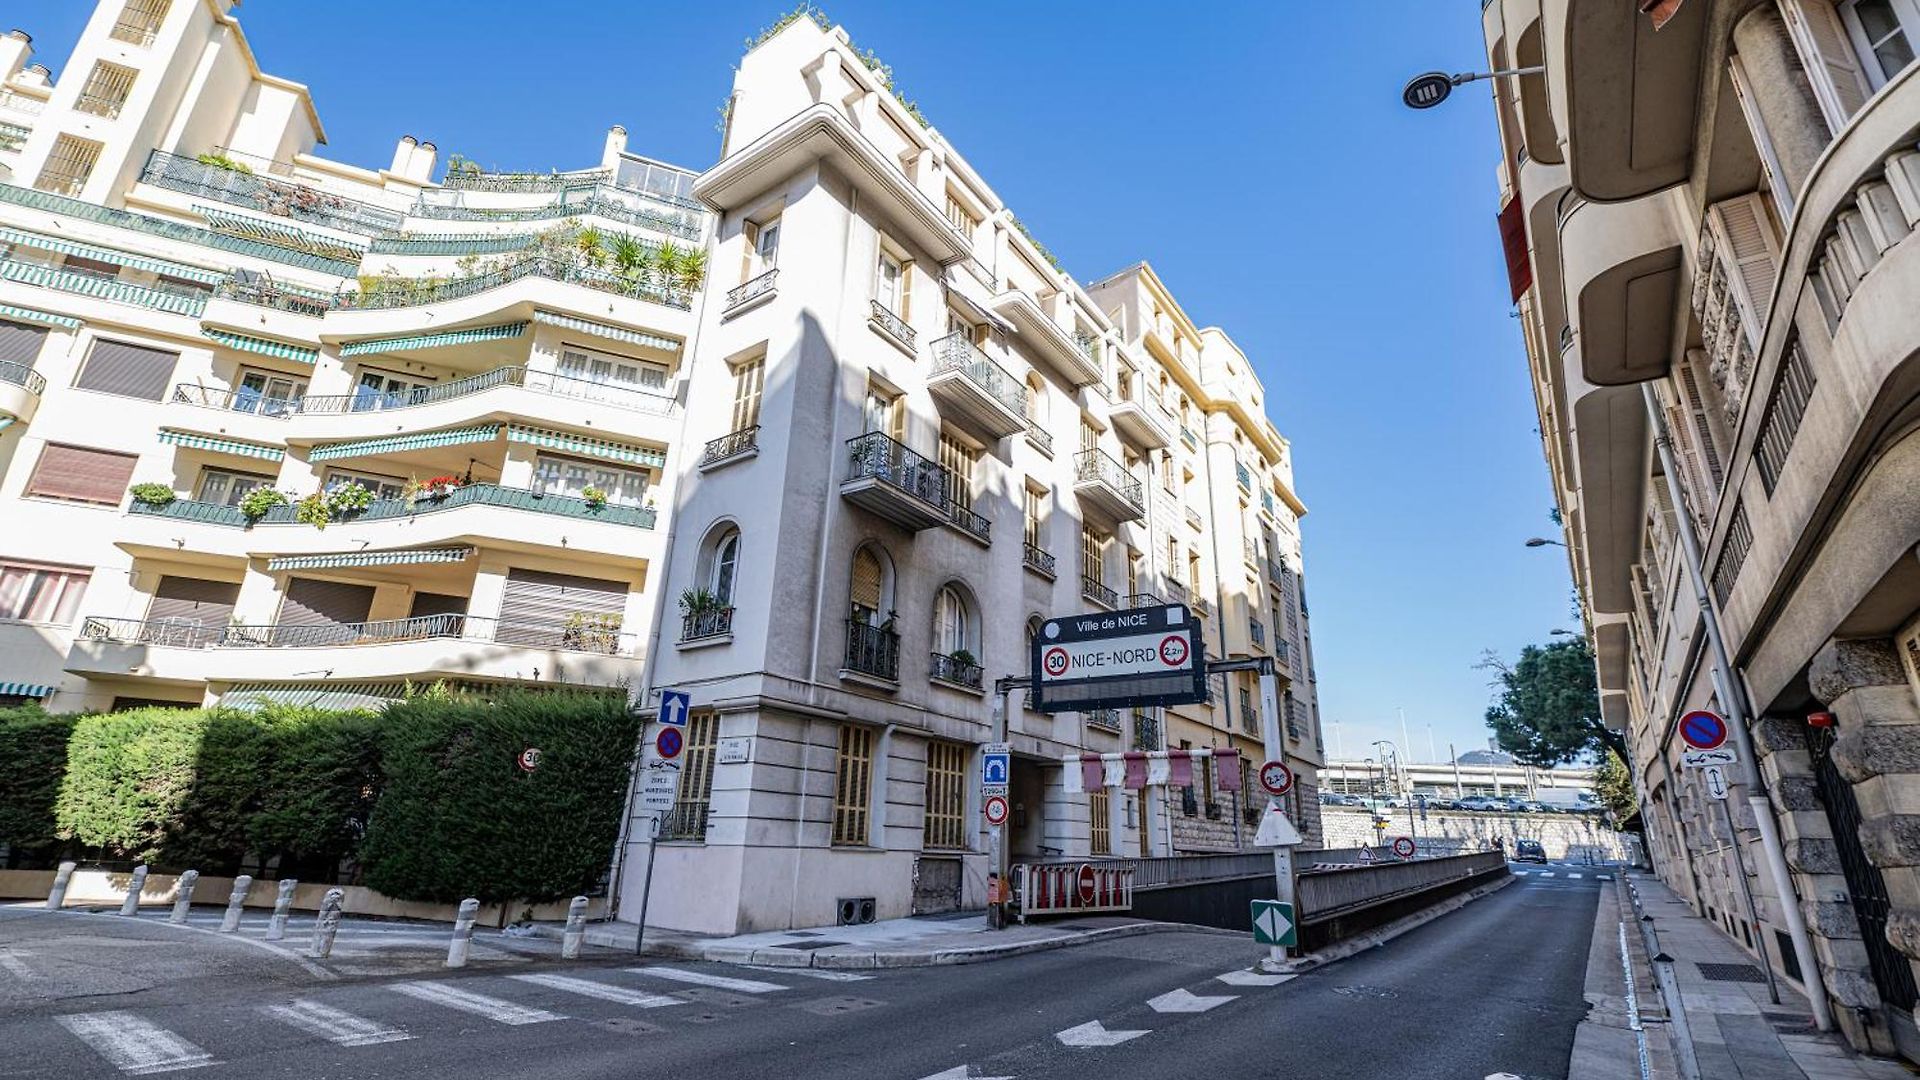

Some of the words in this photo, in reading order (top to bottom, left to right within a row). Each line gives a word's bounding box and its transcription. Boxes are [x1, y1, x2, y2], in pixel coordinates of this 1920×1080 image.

[1076, 620, 1099, 633] Ville
[1101, 618, 1116, 630] de
[1117, 613, 1148, 627] NICE
[1049, 655, 1065, 669] 30
[1072, 648, 1156, 668] NICE-NORD
